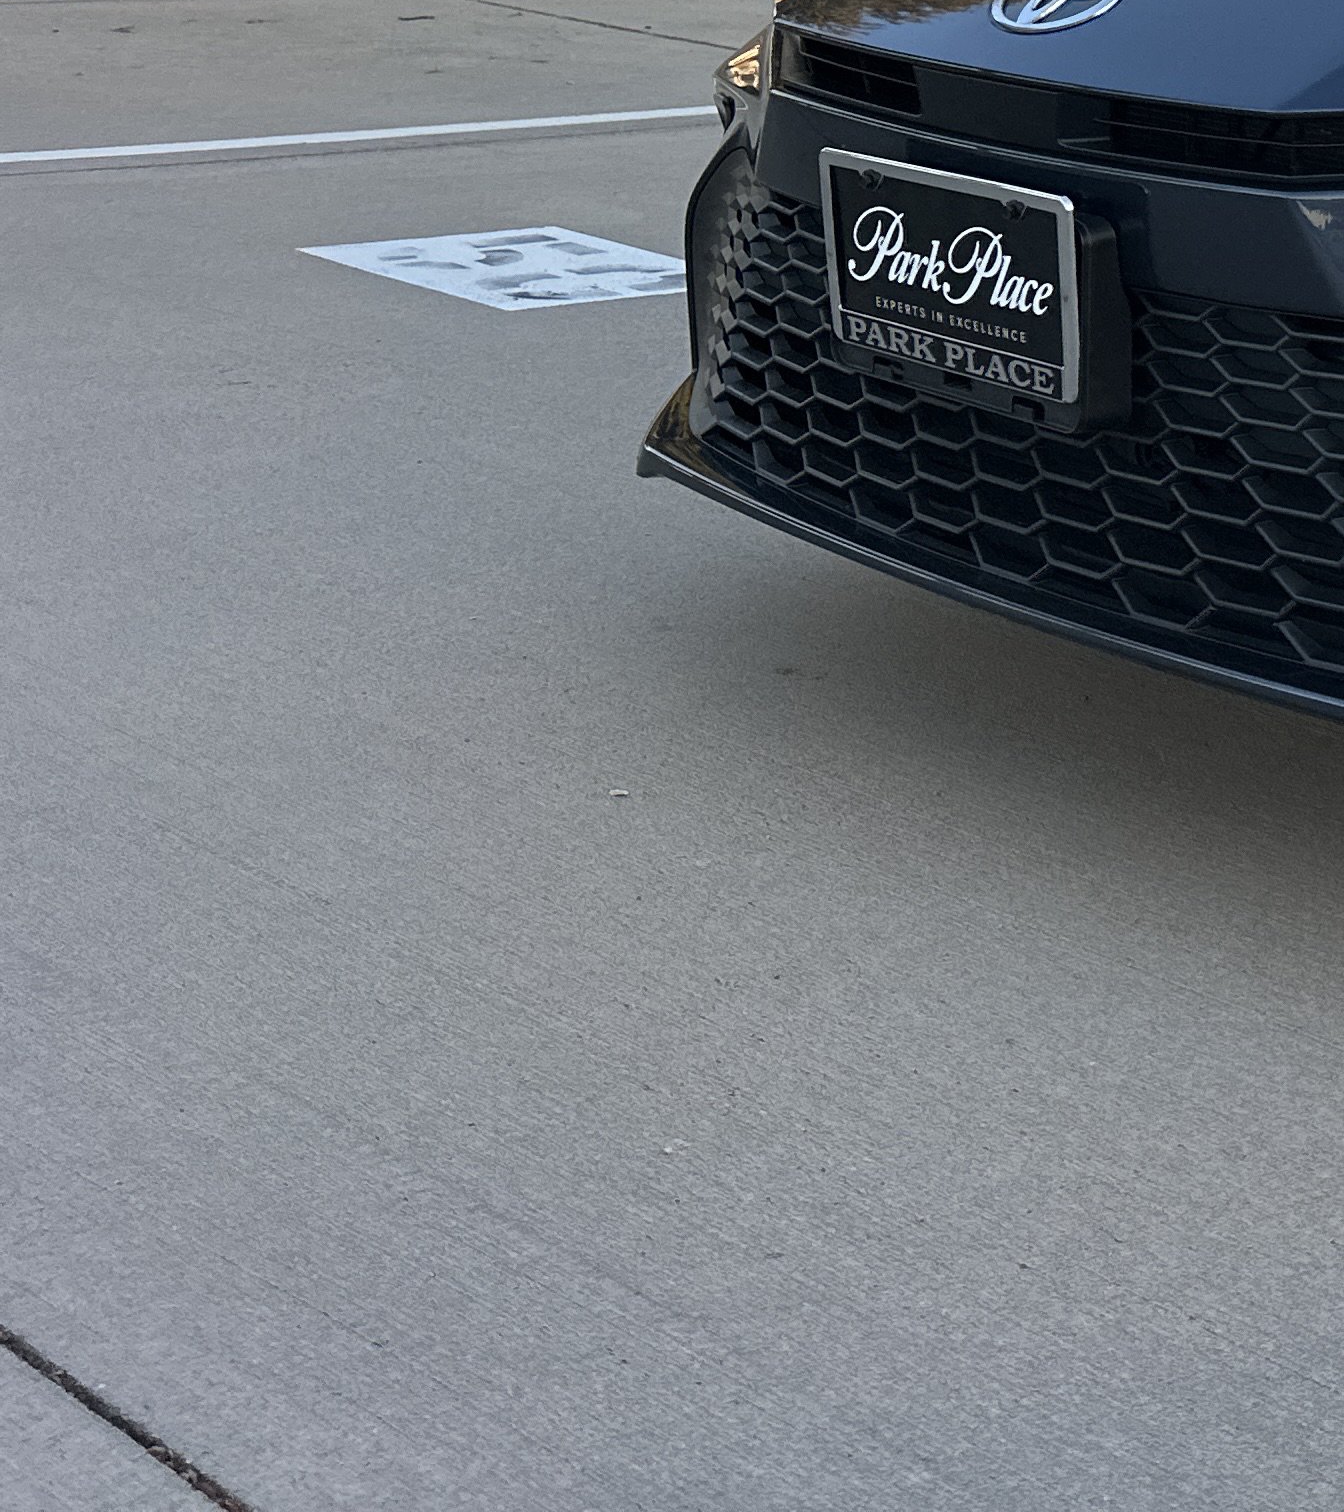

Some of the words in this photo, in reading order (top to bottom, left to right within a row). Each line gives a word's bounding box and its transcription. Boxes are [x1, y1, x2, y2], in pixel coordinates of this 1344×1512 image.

[848, 206, 946, 292] Park
[943, 226, 1054, 316] Place
[847, 314, 936, 363] PARK
[943, 340, 1055, 395] PLACE
[875, 296, 927, 319] EXPERTS
[931, 308, 944, 324] IN
[949, 314, 1028, 344] EXCELLENCE
